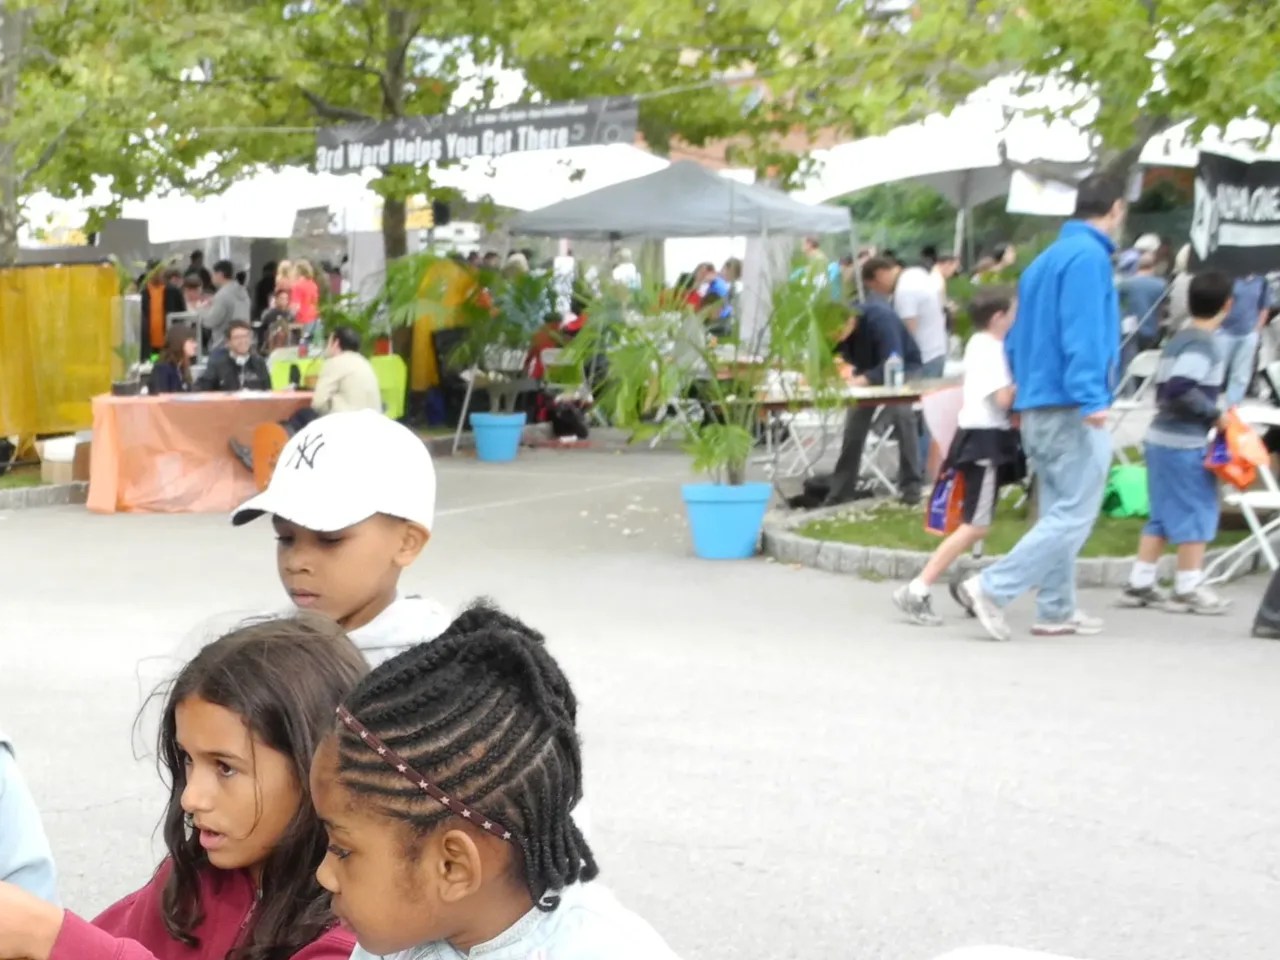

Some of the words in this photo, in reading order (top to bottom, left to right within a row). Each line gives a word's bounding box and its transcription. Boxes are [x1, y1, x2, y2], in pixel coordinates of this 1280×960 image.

[316, 143, 344, 172] 3rd
[347, 138, 391, 168] Ward
[393, 136, 442, 166] Helps
[446, 133, 478, 159] You
[482, 129, 512, 155] Get
[517, 125, 569, 150] There
